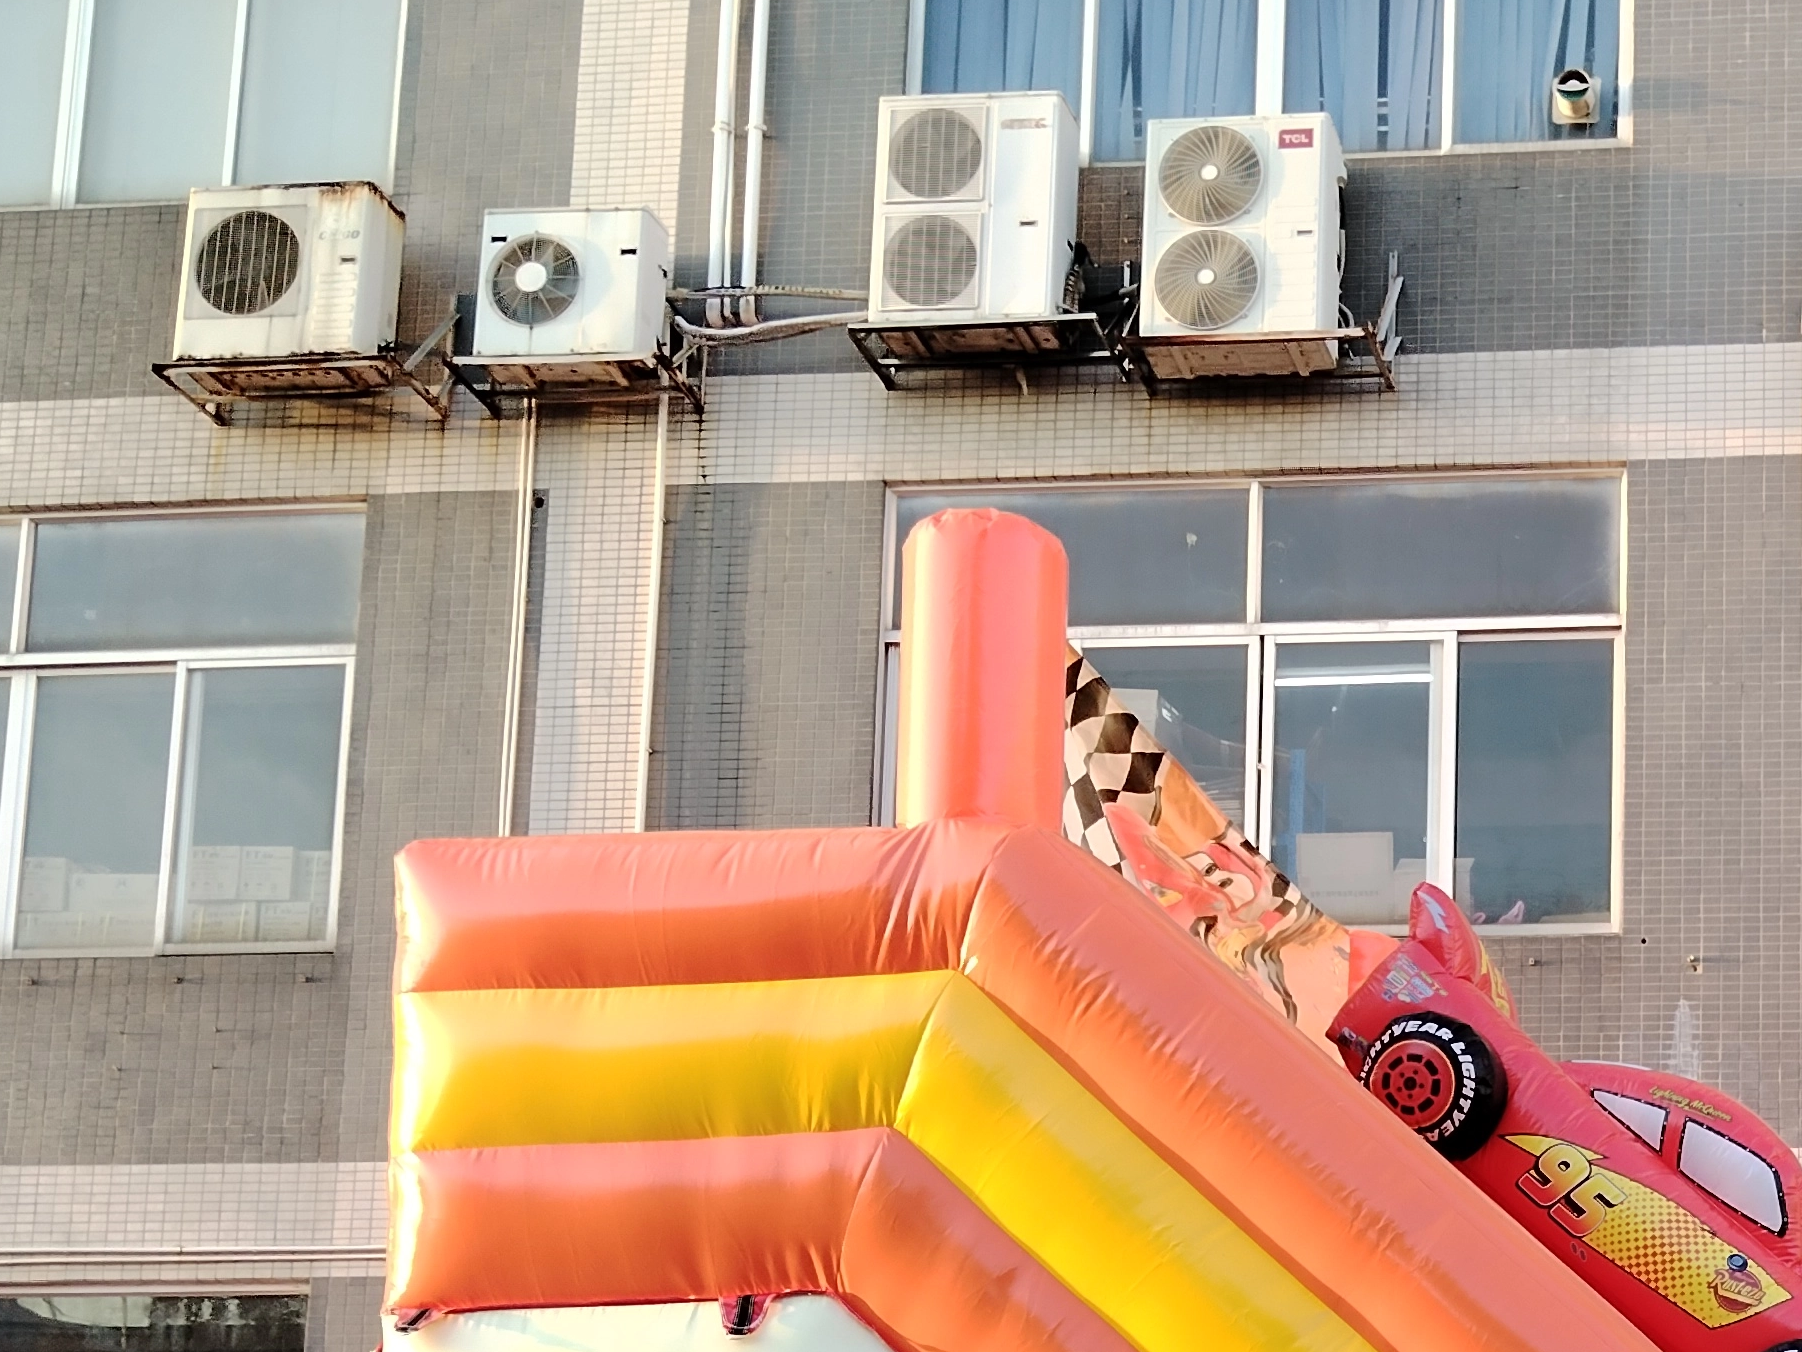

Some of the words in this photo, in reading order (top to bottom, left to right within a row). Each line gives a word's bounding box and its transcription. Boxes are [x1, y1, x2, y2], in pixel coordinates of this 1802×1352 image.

[1281, 133, 1310, 144] TCL
[1417, 1041, 1477, 1142] LIGHTYEA
[1514, 1142, 1628, 1238] 95
